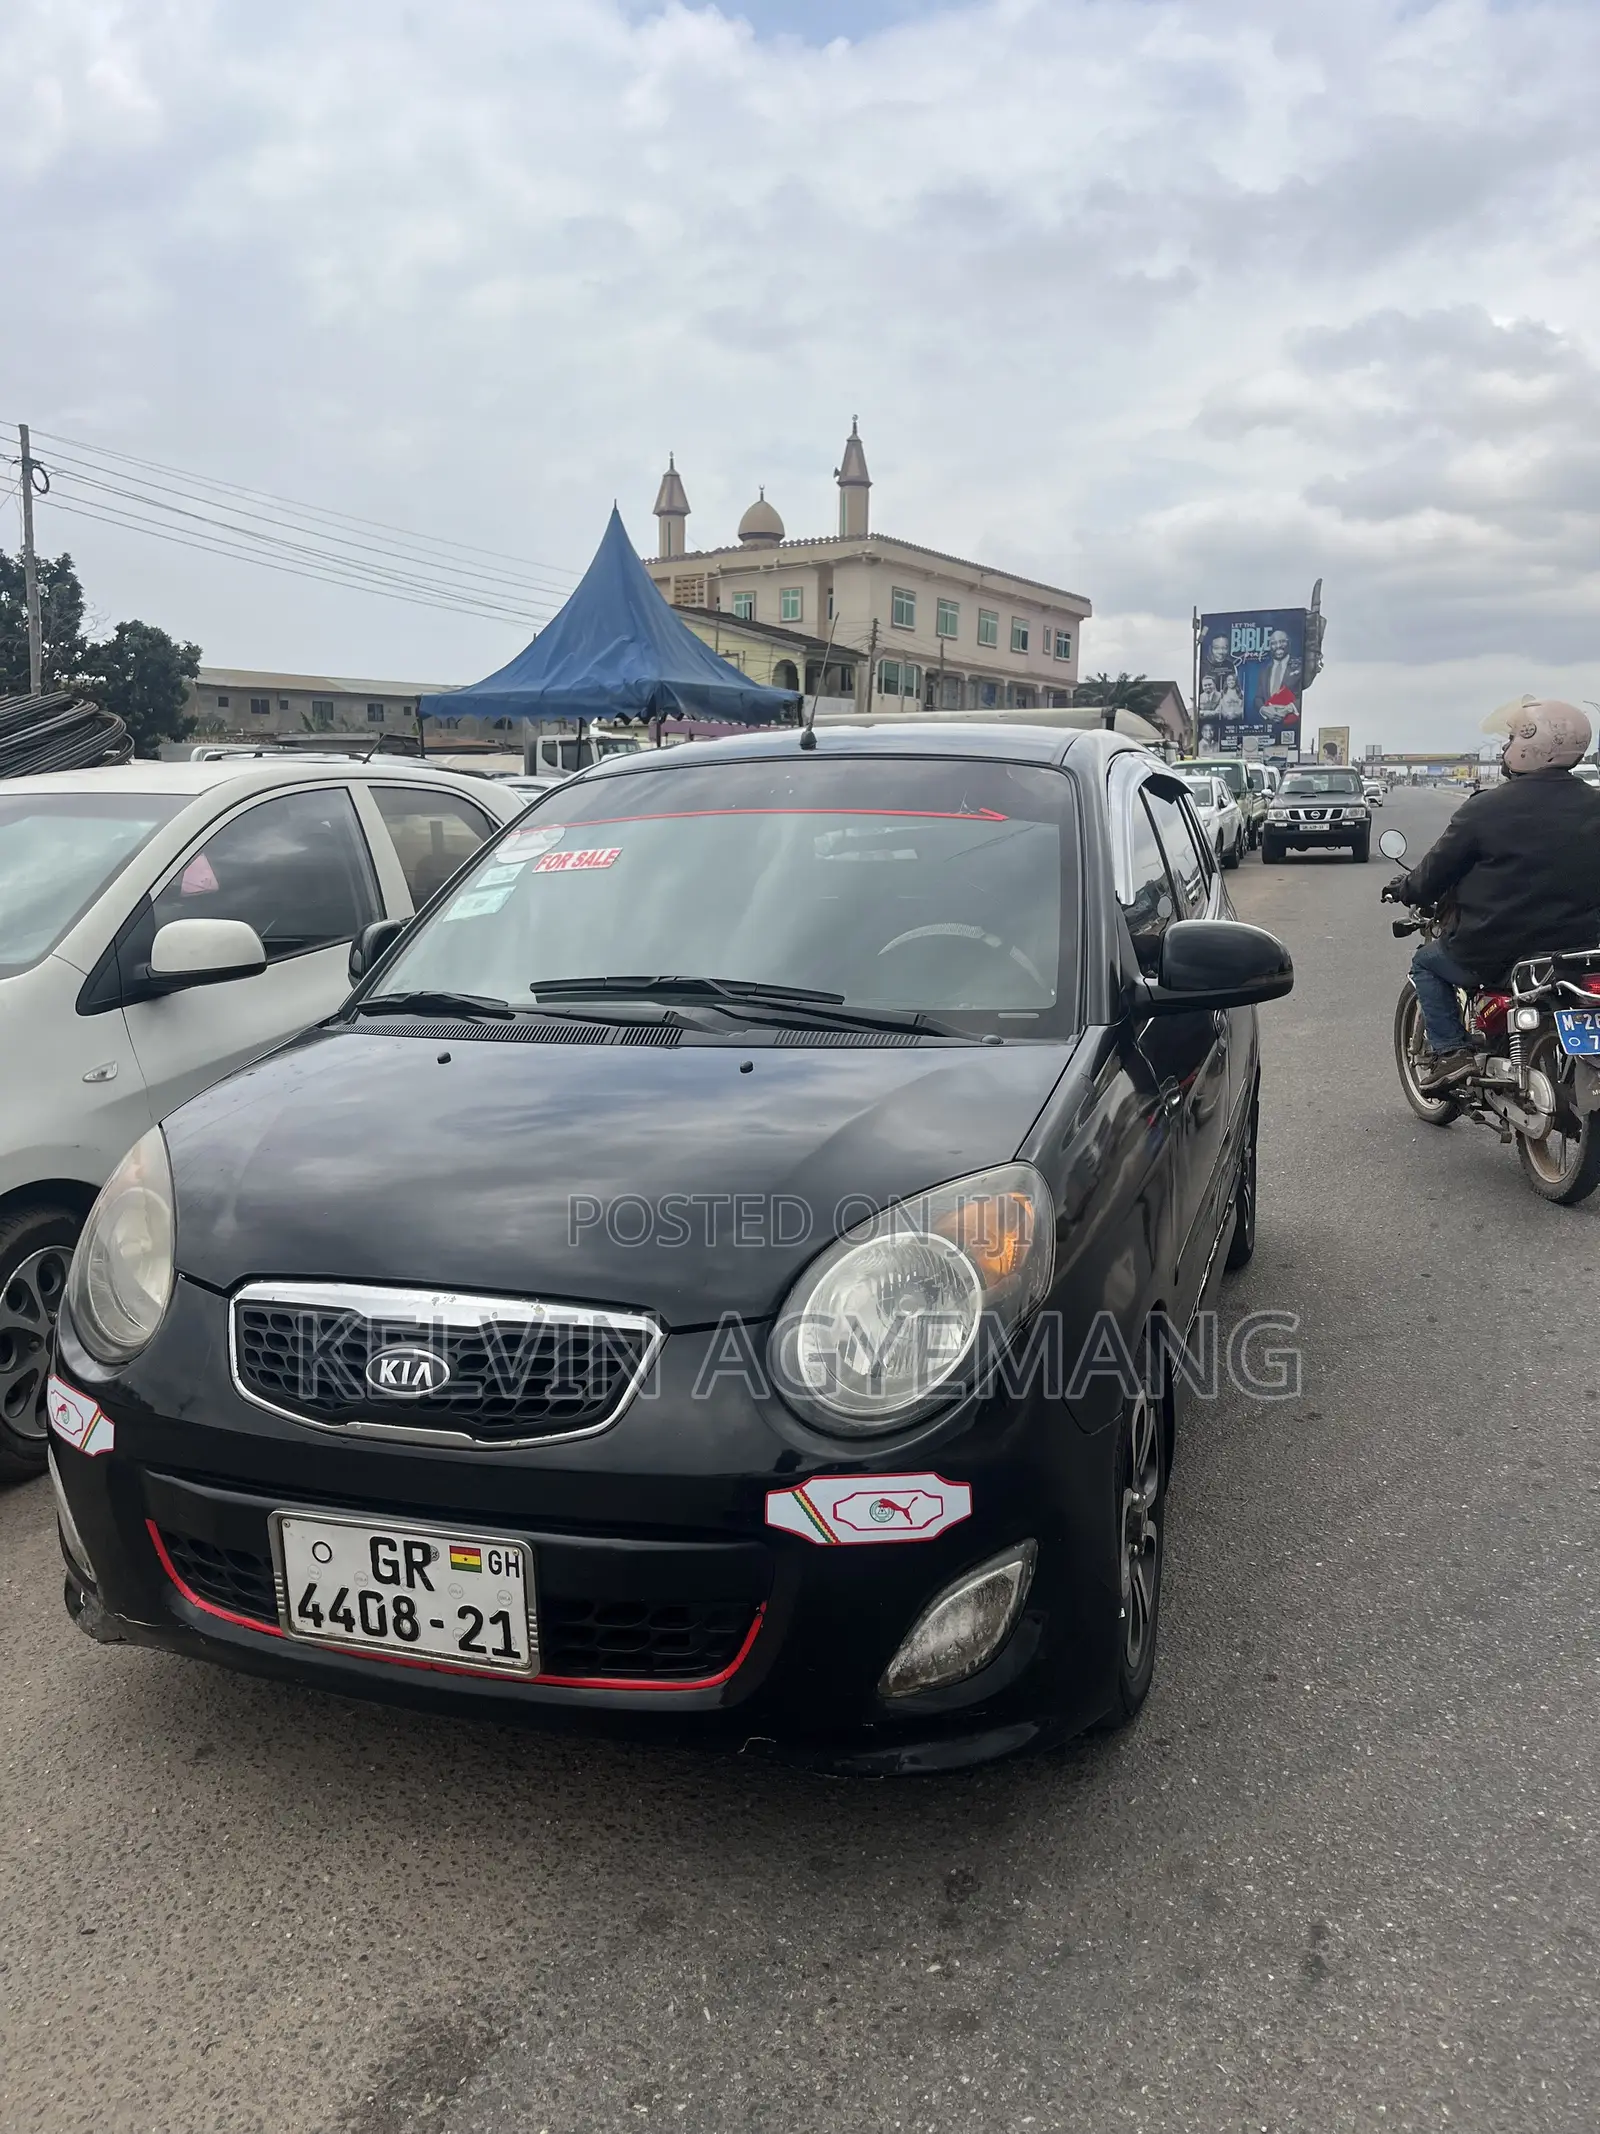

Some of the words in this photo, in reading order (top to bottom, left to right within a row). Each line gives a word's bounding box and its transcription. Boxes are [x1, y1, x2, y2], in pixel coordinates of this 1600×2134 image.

[1231, 626, 1273, 652] BIBLE
[536, 854, 572, 870] FOR
[573, 849, 620, 867] SALE
[379, 1357, 434, 1387] KIA
[369, 1536, 435, 1592] GR
[487, 1549, 521, 1579] GH
